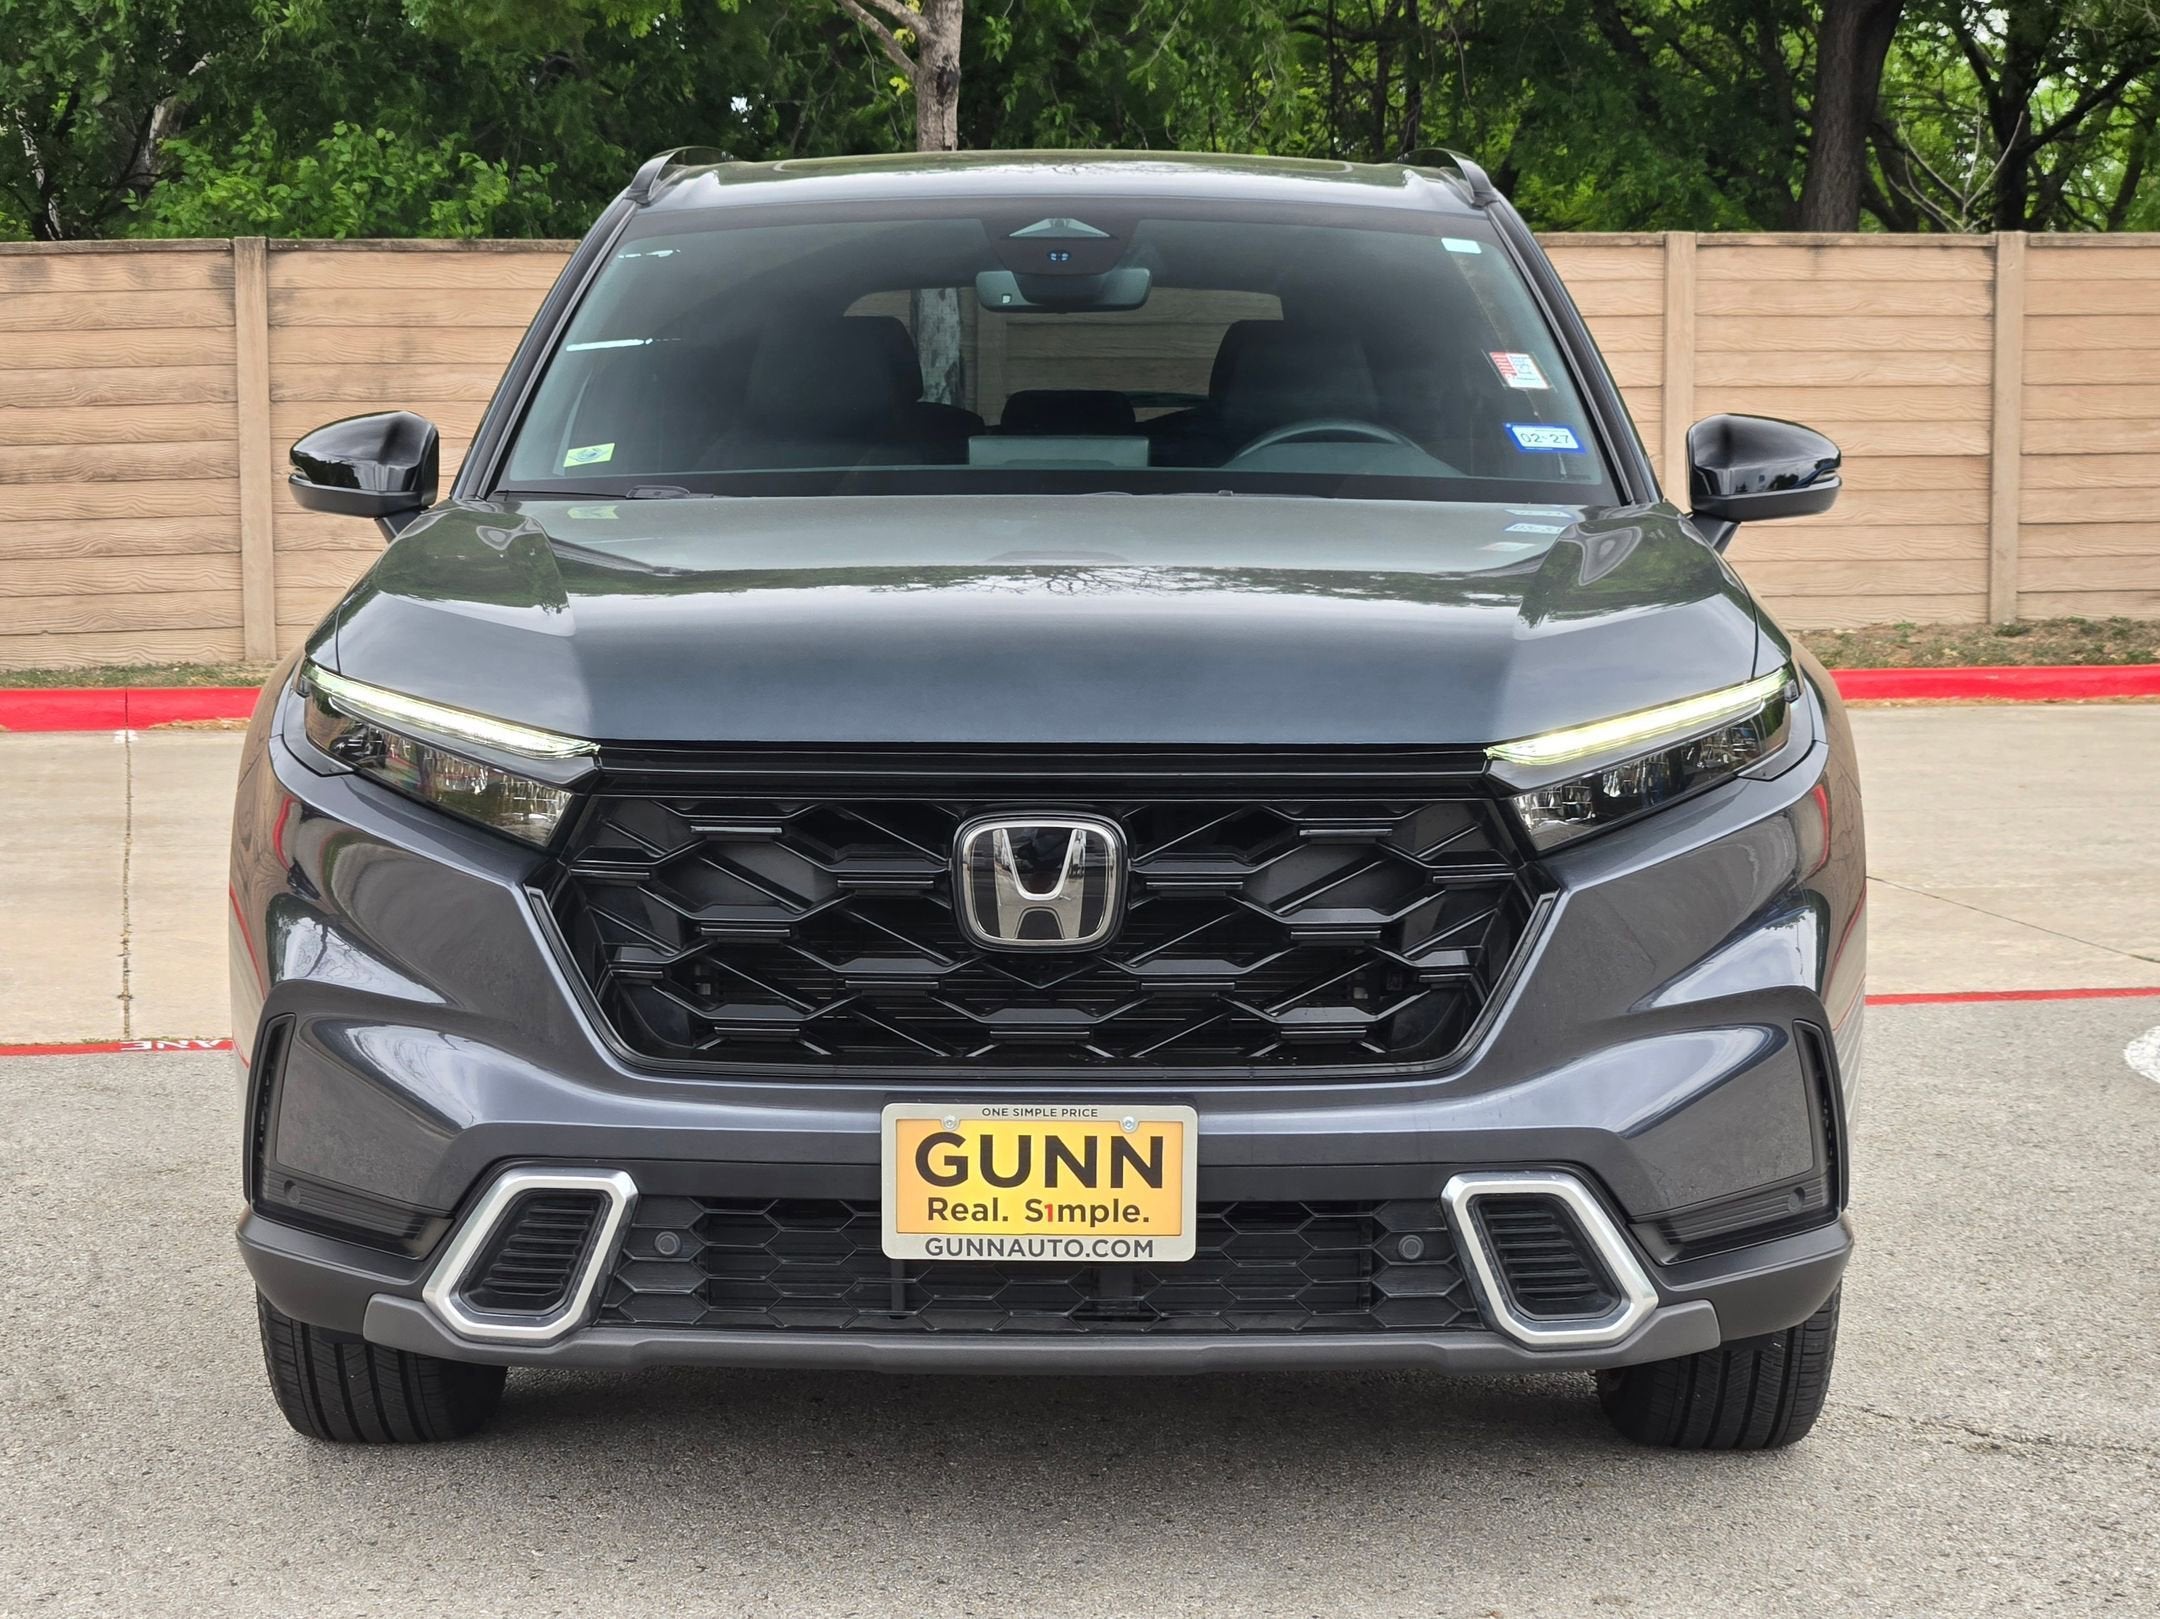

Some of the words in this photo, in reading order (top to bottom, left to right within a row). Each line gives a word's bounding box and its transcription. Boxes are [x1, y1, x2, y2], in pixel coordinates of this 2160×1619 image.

[119, 1039, 224, 1051] ANE
[982, 1108, 1008, 1117] ONE
[1013, 1108, 1057, 1117] SIMPLE
[1061, 1108, 1098, 1118] PRICE
[915, 1131, 1164, 1189] GUNN
[927, 1196, 1008, 1222] Real.
[924, 1237, 1154, 1258] GUNNAUTO.COM
